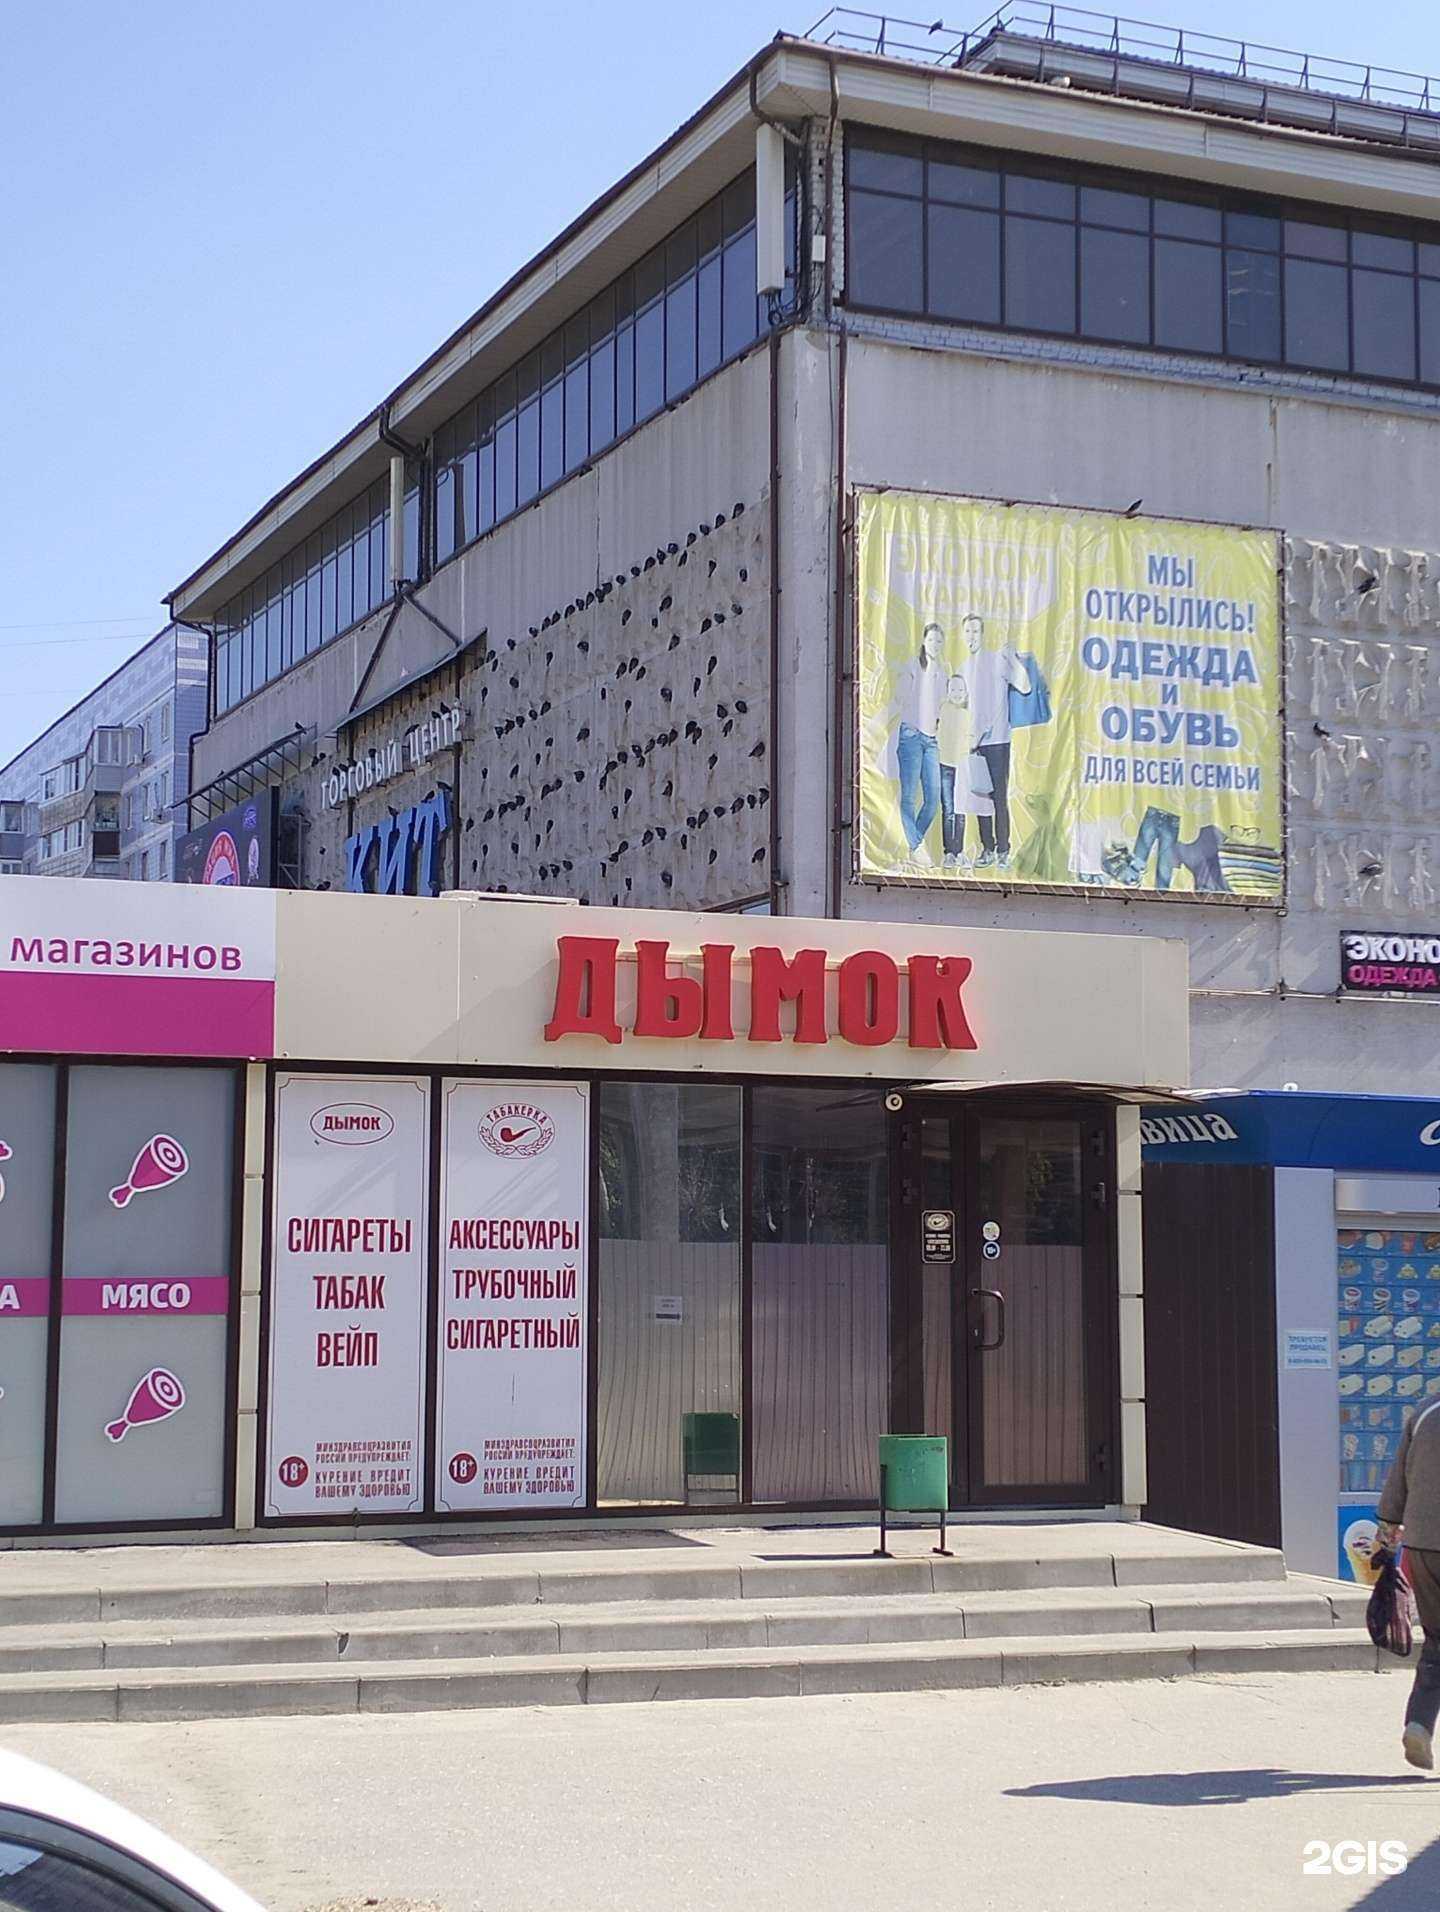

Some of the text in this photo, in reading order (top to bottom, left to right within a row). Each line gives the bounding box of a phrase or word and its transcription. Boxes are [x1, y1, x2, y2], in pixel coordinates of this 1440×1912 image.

[1148, 554, 1194, 588] МЫ
[1086, 589, 1255, 633] ОТКРЫЛИСЬ!
[1082, 636, 1258, 688] ОДЕЖДА
[1162, 684, 1178, 705] И
[1101, 706, 1240, 749] ОБУВЬ
[321, 709, 461, 810] ТОРГОВЫЙ ЦЕНТР
[1084, 754, 1260, 791] ДЛЯ ВСЕЙ СЕМЬИ
[345, 790, 451, 897] КИТ
[10, 937, 242, 971] магазинов
[543, 936, 978, 1050] ДЫМОК
[1348, 965, 1438, 988] ОДЕЖДА
[322, 1115, 381, 1132] ДЫМОК
[486, 1105, 549, 1125] ТАБАКЕРКА
[1141, 1113, 1239, 1145] вица
[288, 1218, 411, 1253] СИГАРЕТЫ
[449, 1219, 579, 1250] АКСЕССУАРЫ
[102, 1283, 191, 1310] МЯСО
[313, 1275, 386, 1310] ТАБАК
[452, 1262, 576, 1300] ТРУБОЧНЫЙ
[317, 1323, 378, 1368] ВЕЙП
[447, 1312, 580, 1350] СИГАРЕТНЫЙ
[281, 1462, 306, 1482] 18+
[315, 1469, 411, 1484] КУРЕНИЕ ВРЕДИТ
[451, 1459, 475, 1479] 18+
[484, 1466, 575, 1480] КУРЕНИЕ ВРЕДИТ
[315, 1483, 411, 1498] ВАШЕМУ ЗДОРОВЬЮ
[483, 1480, 575, 1494] ВАШЕМУ ЗДОРОВЬЮ
